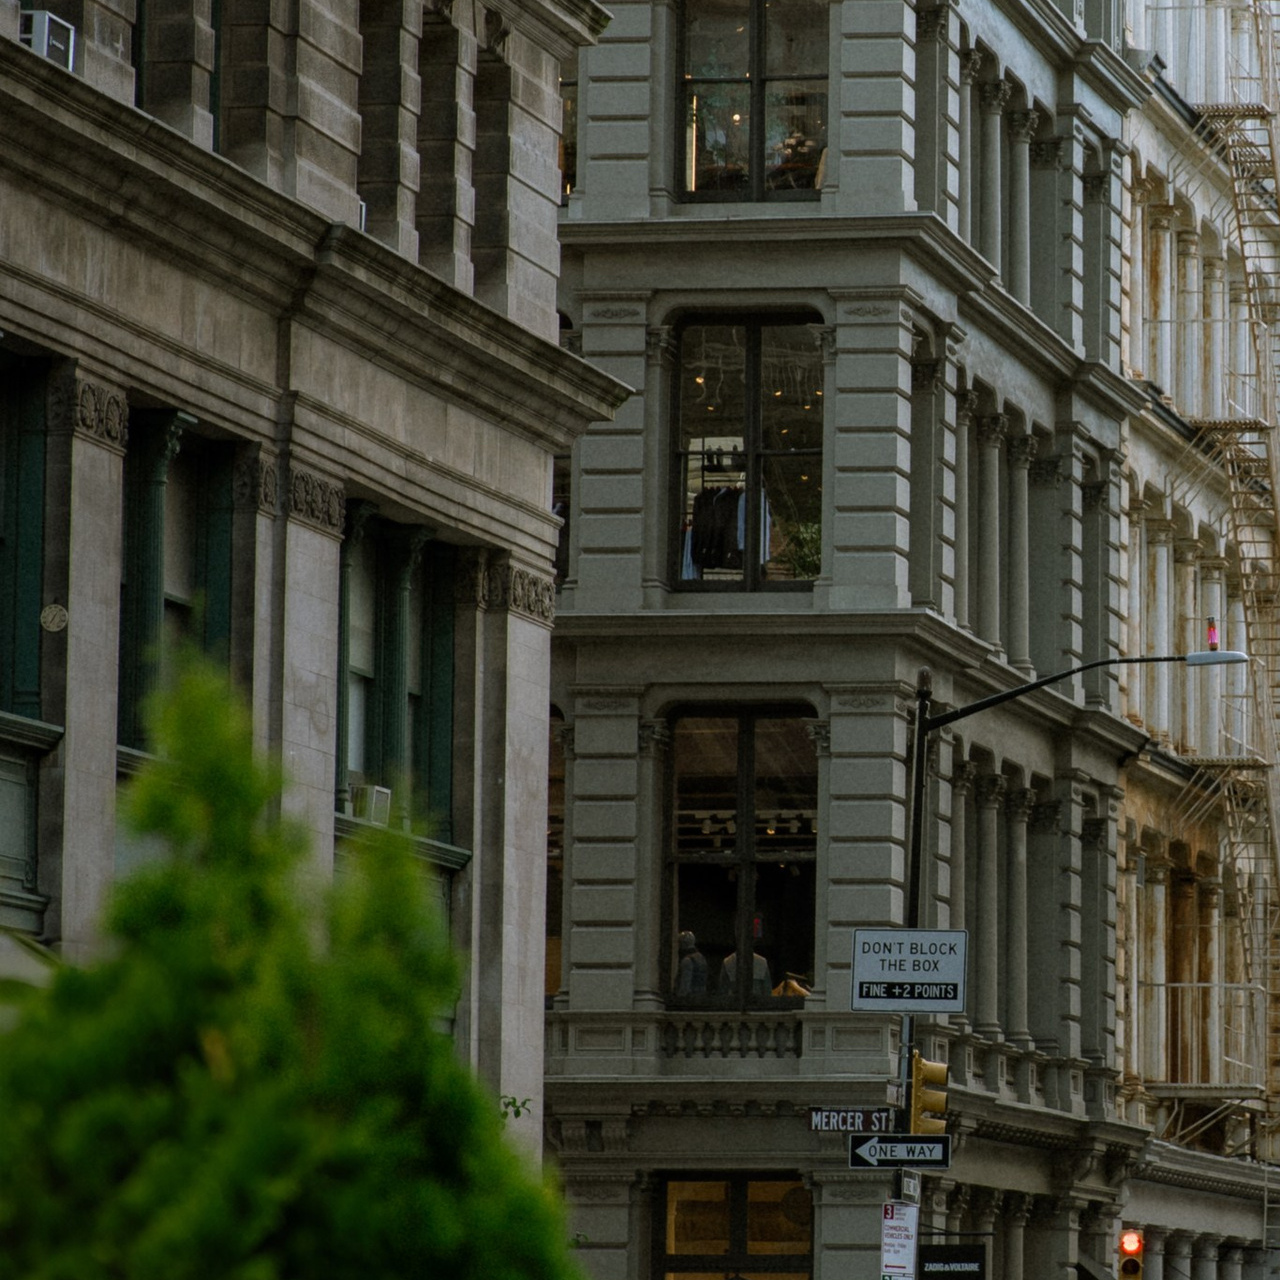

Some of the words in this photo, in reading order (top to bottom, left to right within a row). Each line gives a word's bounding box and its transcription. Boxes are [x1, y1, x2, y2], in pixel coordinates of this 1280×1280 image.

[862, 942, 904, 955] DON'T
[910, 942, 957, 955] BLOCK
[880, 958, 907, 972] THE
[912, 959, 940, 972] BOX
[862, 983, 888, 997] FINE
[892, 984, 911, 998] +2
[914, 984, 954, 998] POINTS
[811, 1111, 863, 1131] MERCER
[871, 1112, 888, 1131] ST
[868, 1145, 898, 1158] ONE
[906, 1145, 936, 1158] WAY
[885, 1205, 892, 1219] 3
